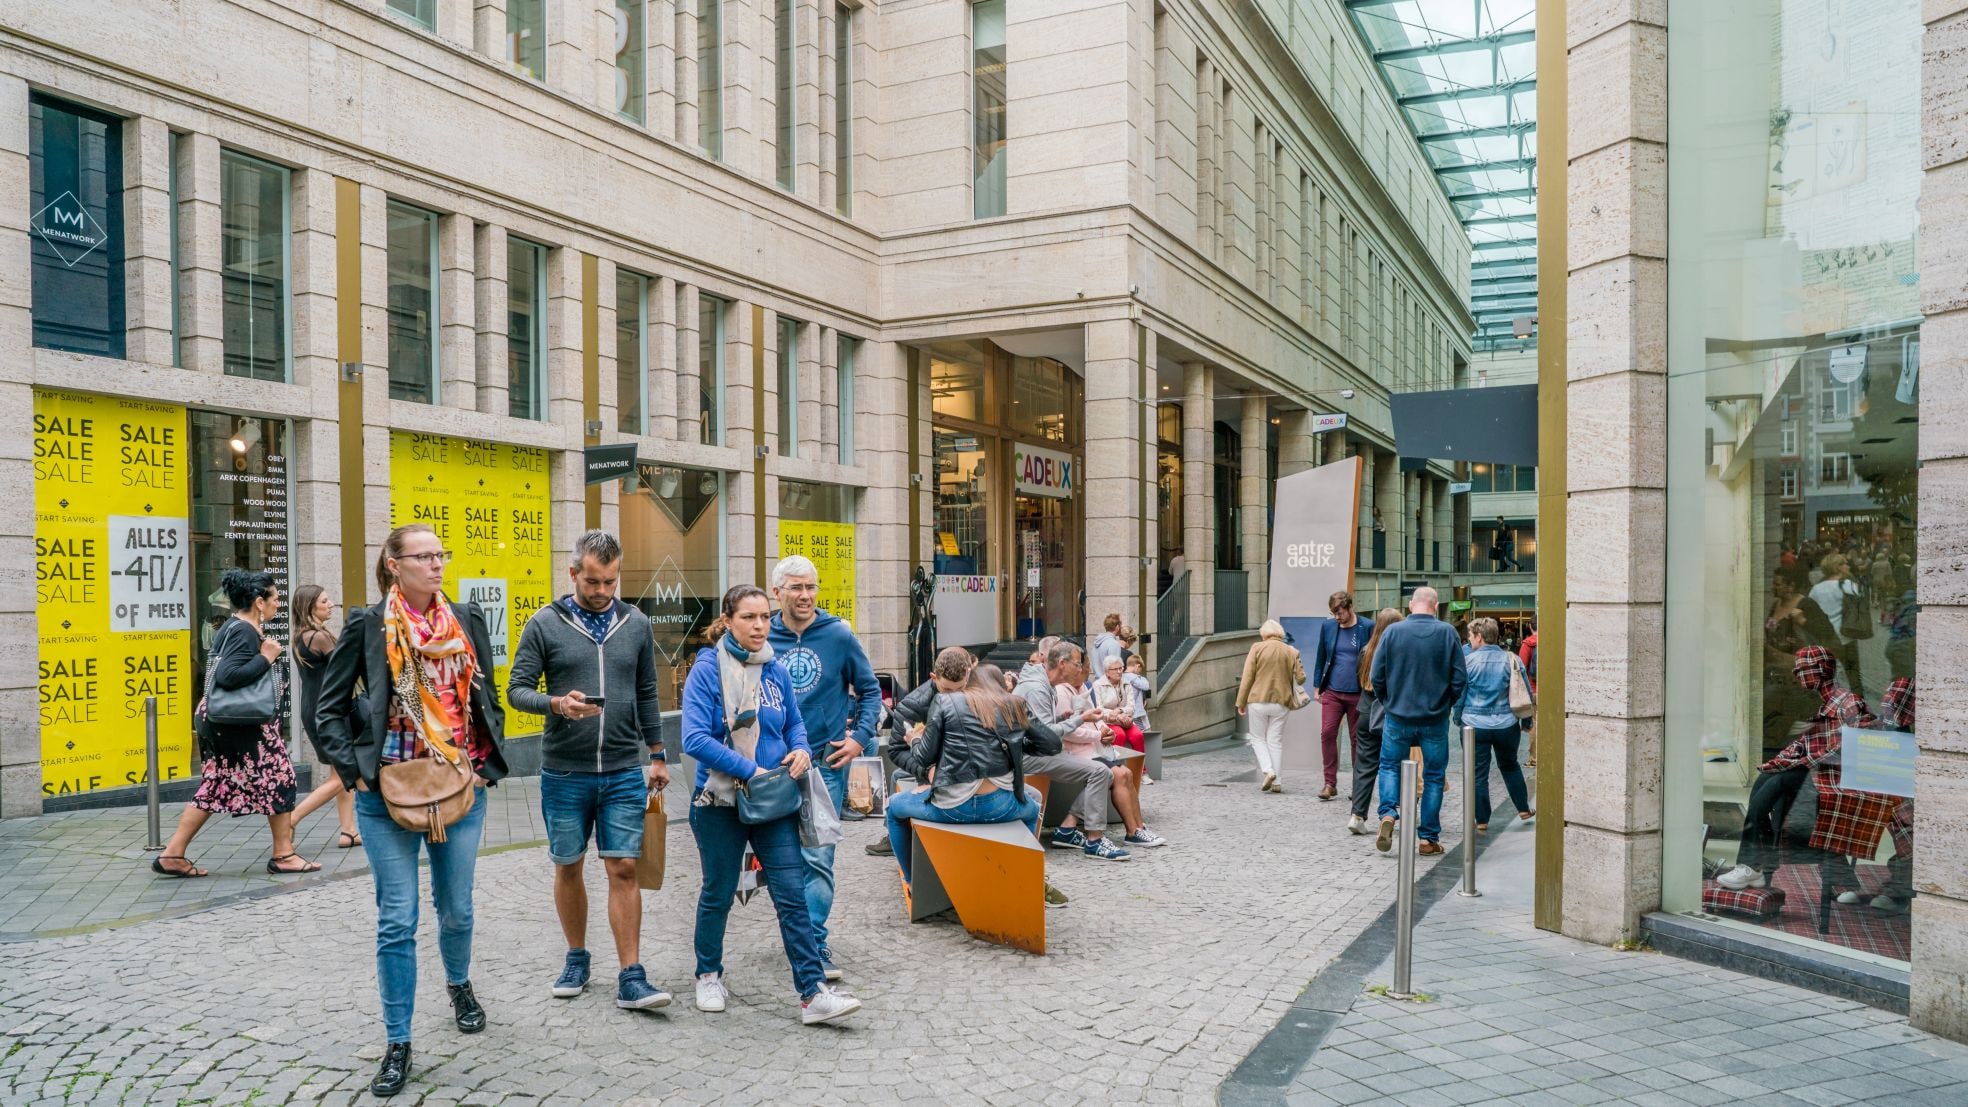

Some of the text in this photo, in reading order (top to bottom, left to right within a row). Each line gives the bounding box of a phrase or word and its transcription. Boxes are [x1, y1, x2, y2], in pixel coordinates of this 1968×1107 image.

[42, 227, 96, 244] MENATWORK
[60, 393, 93, 404] SAVING
[119, 401, 175, 414] START SAVING
[33, 414, 93, 438] SALE
[120, 423, 175, 446] SALE
[33, 438, 93, 461] SALE
[120, 446, 175, 468] SALE
[412, 445, 449, 464] SALE
[464, 450, 497, 468] SALE
[511, 455, 543, 473] SALE
[589, 460, 629, 470] MENATWORK
[34, 461, 94, 483] SALE
[121, 467, 175, 489] SALE
[1015, 452, 1072, 489] CADEUX
[220, 474, 285, 485] ARKK COPENHAGEN
[266, 488, 286, 496] PUMA
[243, 498, 265, 506] WOOD
[62, 515, 95, 524] SAVING
[264, 511, 286, 519] ELVINE
[413, 503, 449, 521] SALE
[465, 507, 498, 523] SALE
[512, 509, 543, 525] SALE
[229, 520, 287, 530] KAPPA AUTHENTIC
[465, 525, 498, 540] SALE
[125, 527, 177, 549] ALLES
[256, 533, 287, 541] RIHANNA
[513, 526, 543, 542] SALE
[785, 534, 804, 546] SALE
[811, 535, 829, 546] SALE
[835, 536, 853, 547] SALE
[35, 537, 95, 558] SALE
[271, 544, 287, 552] NIKE
[465, 541, 499, 557] SALE
[513, 542, 544, 558] SALE
[811, 547, 829, 559] SALE
[836, 548, 853, 559] SALE
[1286, 539, 1336, 555] entre
[1286, 551, 1336, 568] deux.
[36, 562, 96, 581] SALE
[111, 554, 184, 592] -40%
[961, 576, 996, 593] CADEUX
[36, 584, 96, 604] SALE
[470, 586, 502, 603] ALLES
[514, 596, 545, 610] SALE
[836, 599, 853, 609] SALE
[115, 603, 187, 628] OF MEER
[38, 635, 98, 645] TART SAVING
[149, 633, 178, 641] SAVING
[39, 658, 98, 679] SALE
[124, 654, 178, 674] SALE
[39, 681, 98, 703] SALE
[125, 676, 178, 697] SALE
[39, 703, 98, 726] SALE
[40, 753, 102, 766] START SAVING
[125, 748, 146, 757] STAR
